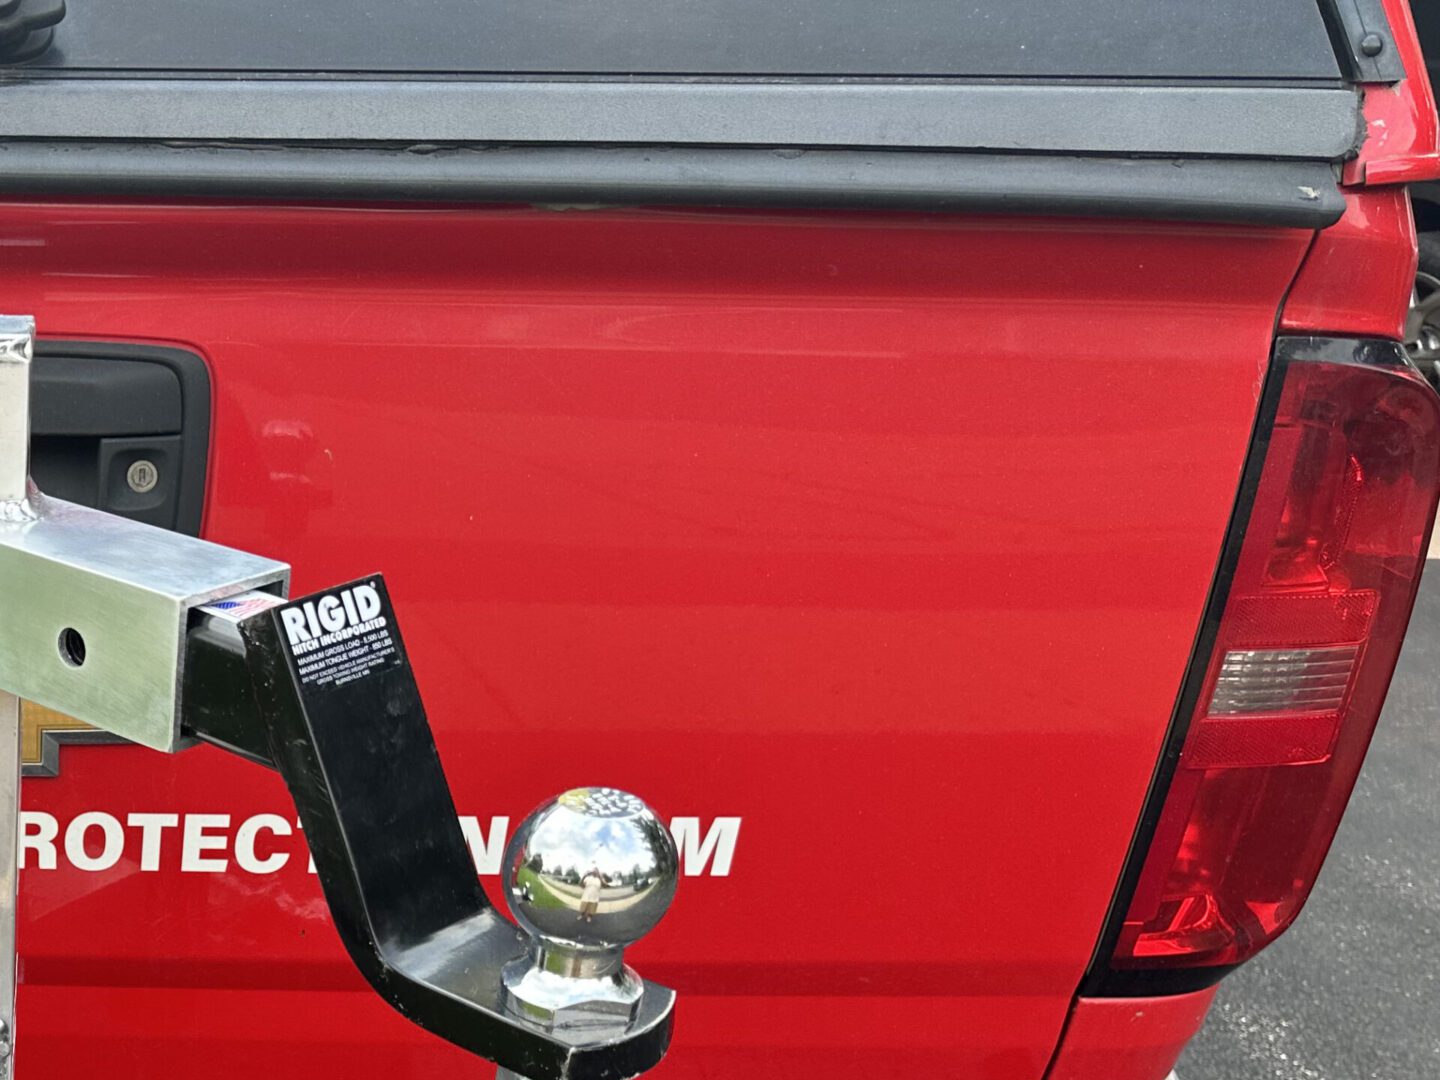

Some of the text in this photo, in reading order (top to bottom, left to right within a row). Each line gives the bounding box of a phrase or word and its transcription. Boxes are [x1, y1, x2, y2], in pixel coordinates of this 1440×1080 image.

[281, 584, 381, 645] RIGID
[291, 617, 386, 656] HITCH INCORPORATED
[297, 651, 324, 666] MAXIMUM
[299, 660, 326, 675] MAXIMUM
